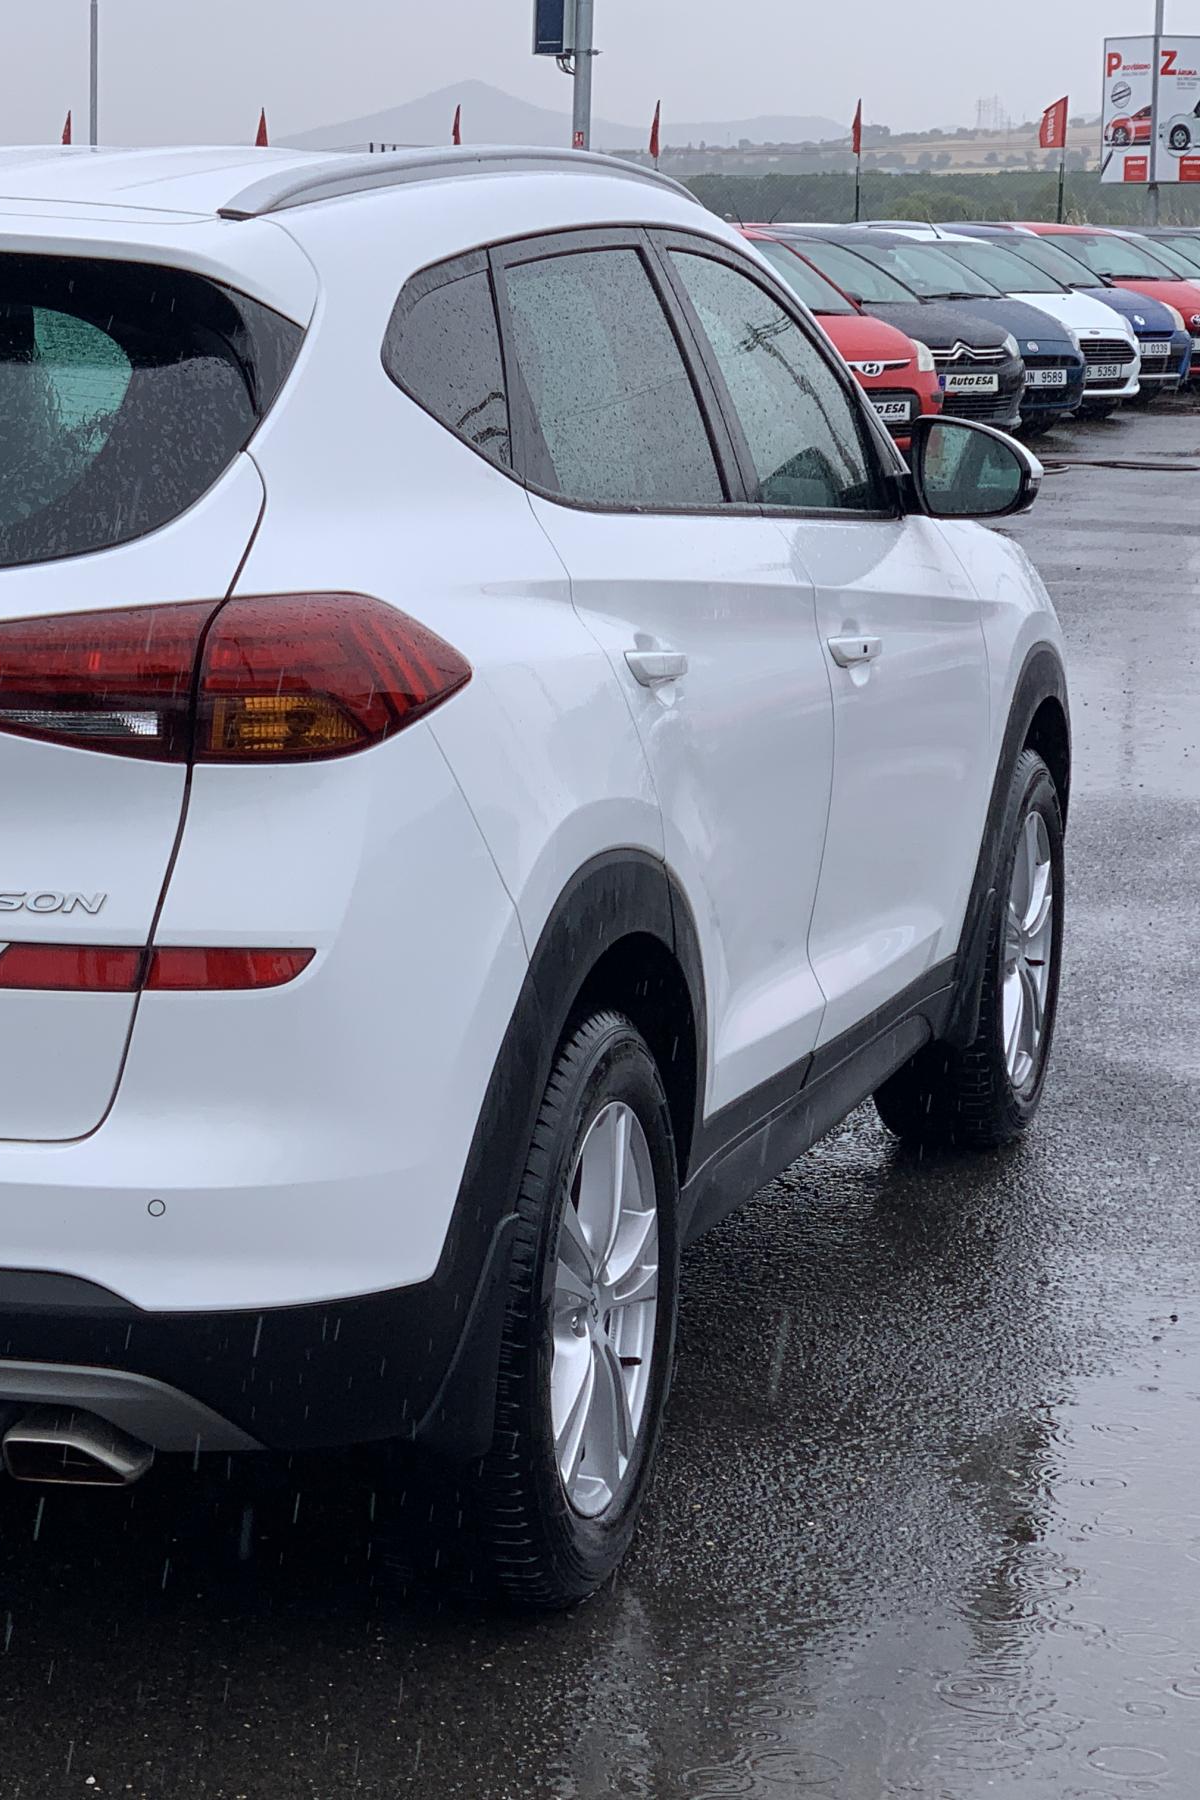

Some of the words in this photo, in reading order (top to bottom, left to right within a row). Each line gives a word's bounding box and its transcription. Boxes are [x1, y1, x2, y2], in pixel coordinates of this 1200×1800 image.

[1097, 365, 1117, 377] 5358
[949, 375, 975, 386] Auto
[975, 375, 994, 385] ESA
[1041, 371, 1063, 383] 9589
[884, 403, 906, 414] ESA
